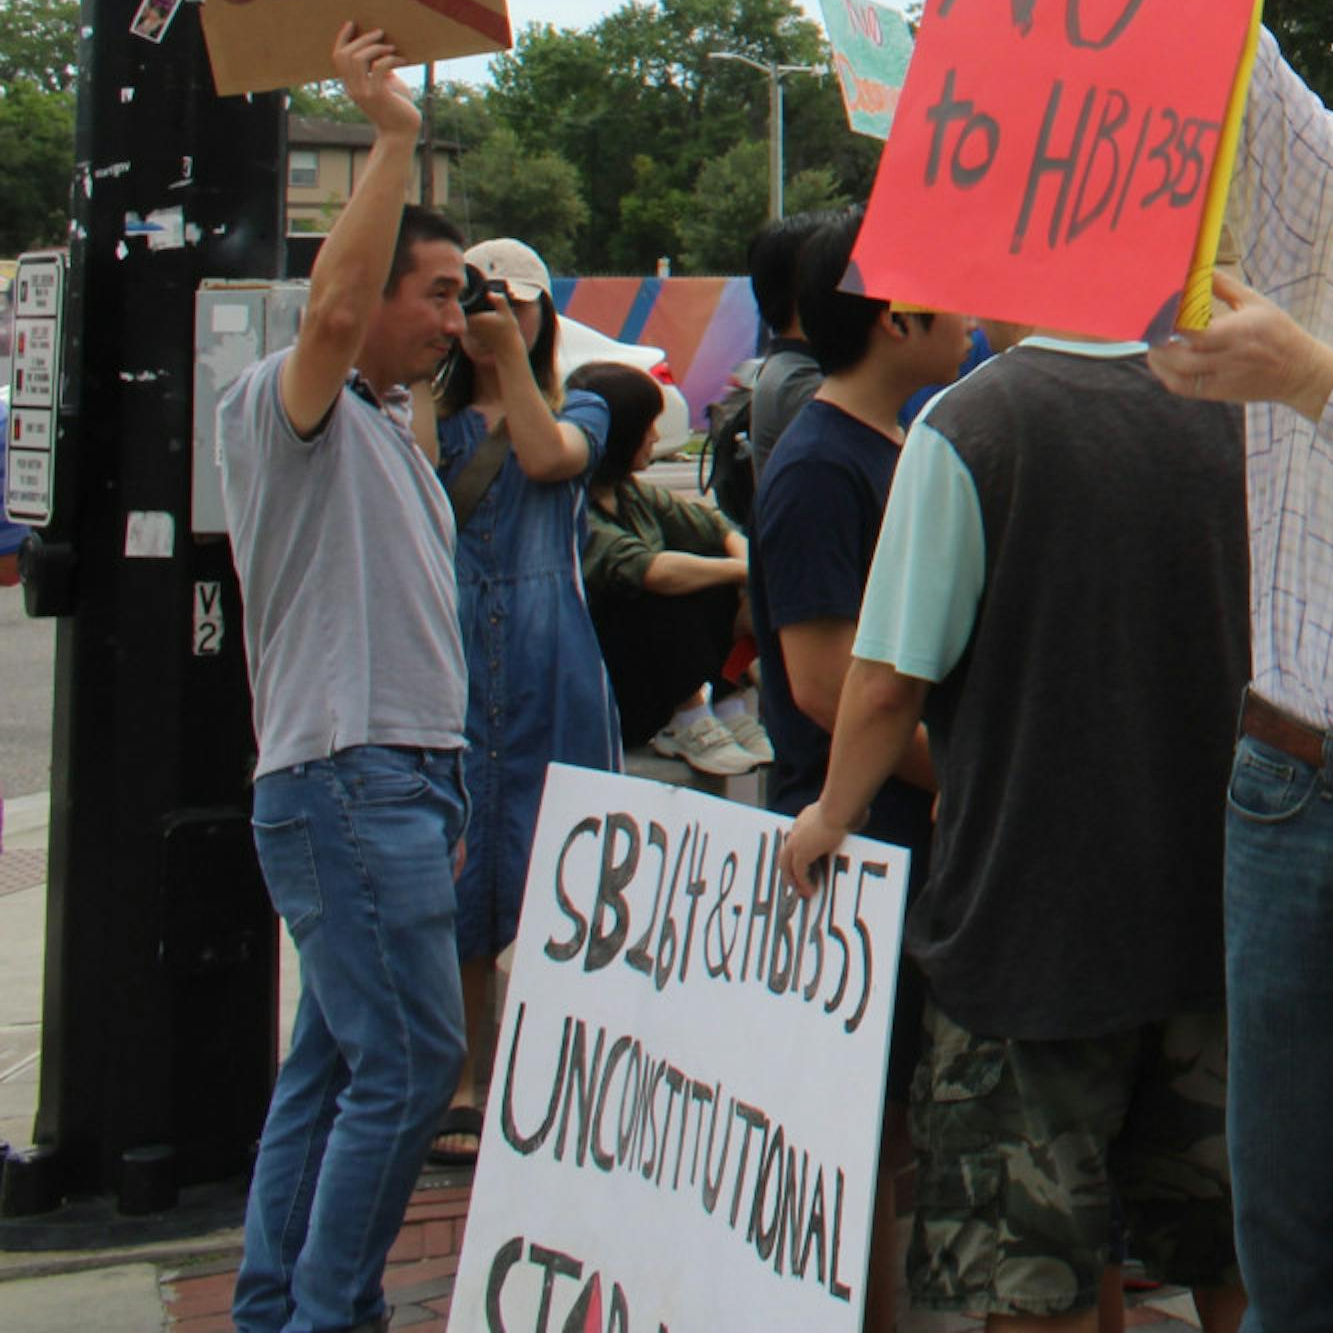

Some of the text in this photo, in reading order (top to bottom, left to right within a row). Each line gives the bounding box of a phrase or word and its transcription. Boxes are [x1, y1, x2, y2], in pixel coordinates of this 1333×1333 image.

[924, 69, 1002, 191] to
[704, 850, 744, 983] &
[740, 825, 889, 1034] HB1355
[500, 1001, 853, 1301] UNCONSTITUTIONAL
